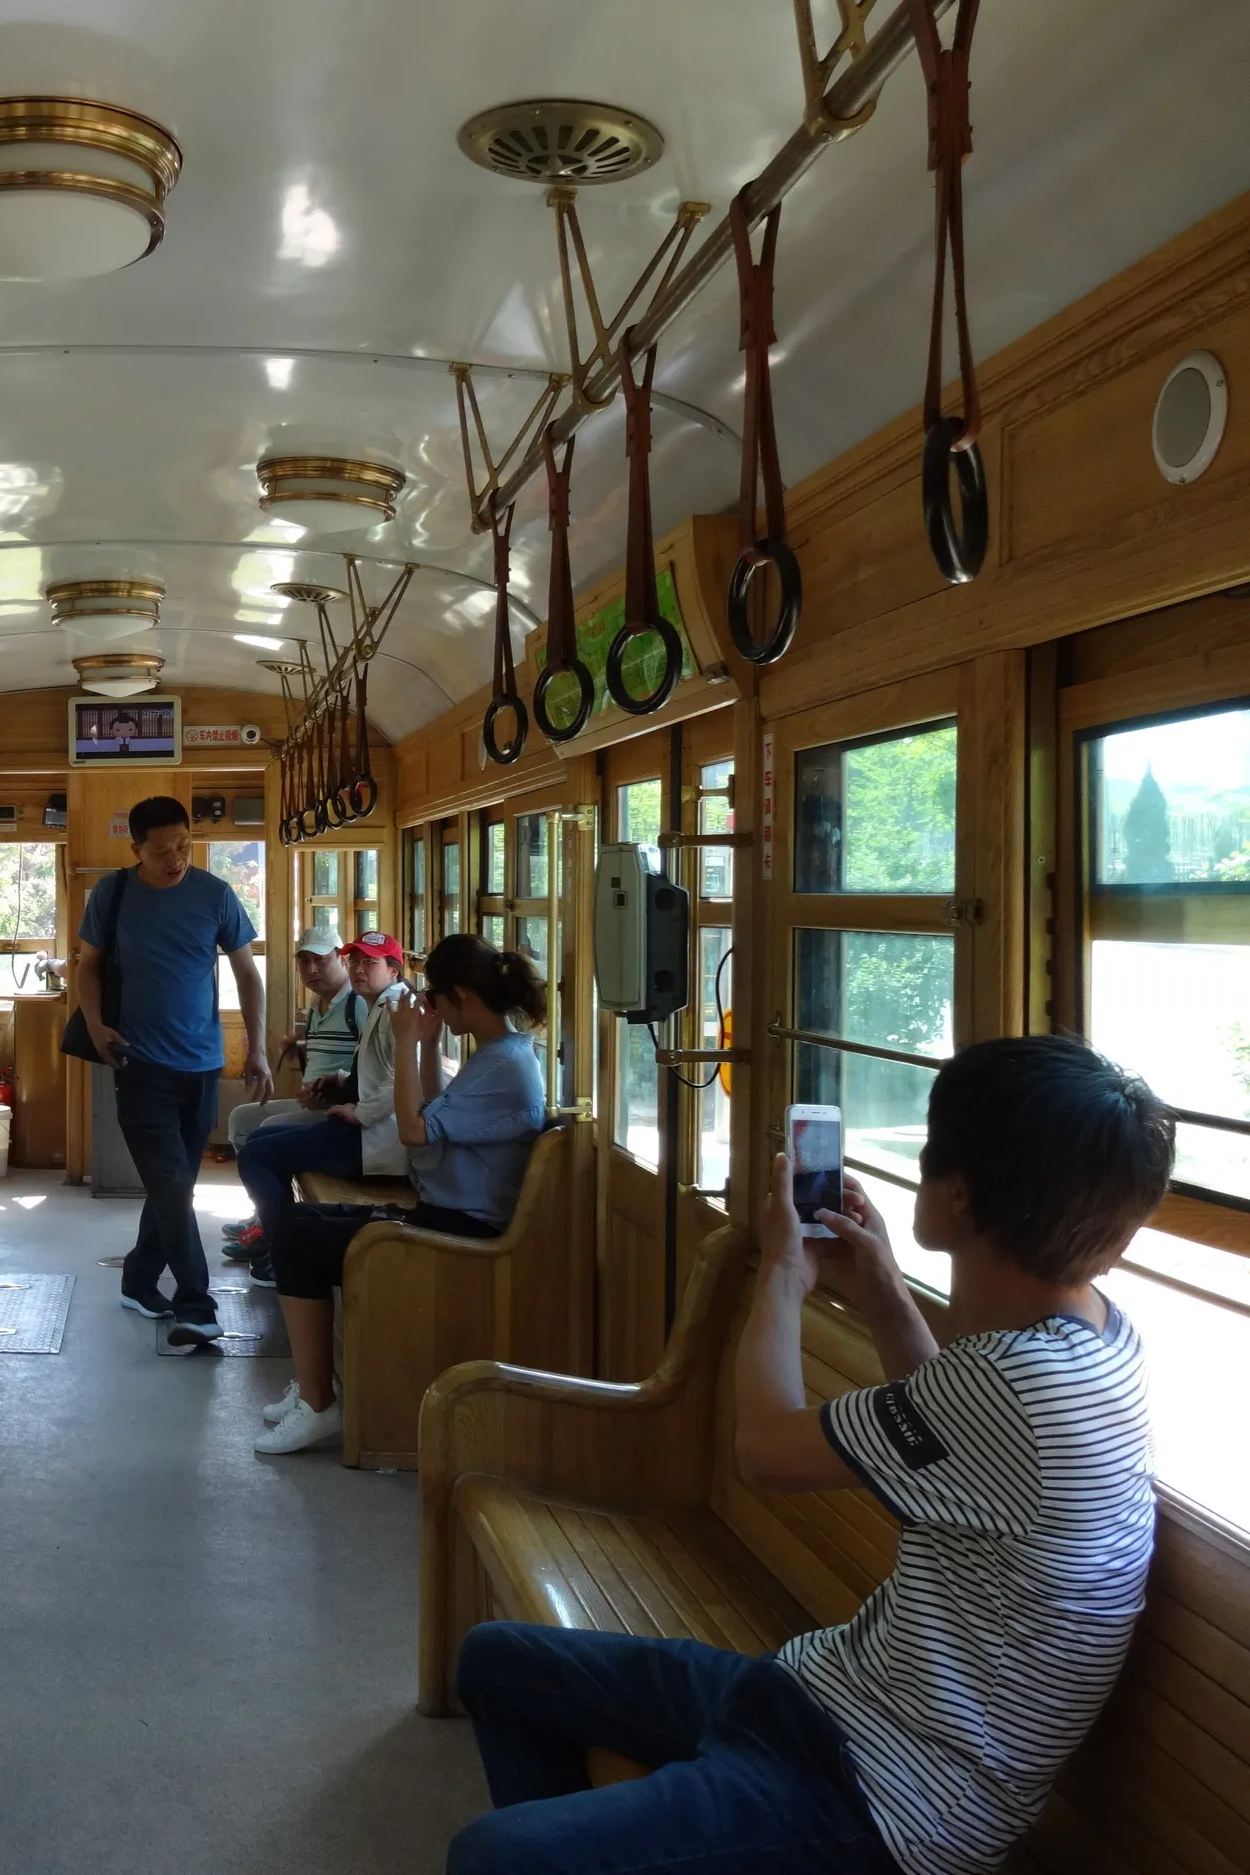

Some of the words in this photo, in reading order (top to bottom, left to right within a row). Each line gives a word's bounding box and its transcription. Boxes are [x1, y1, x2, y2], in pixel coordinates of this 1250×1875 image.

[198, 729, 239, 742] 车内禁止吸烟
